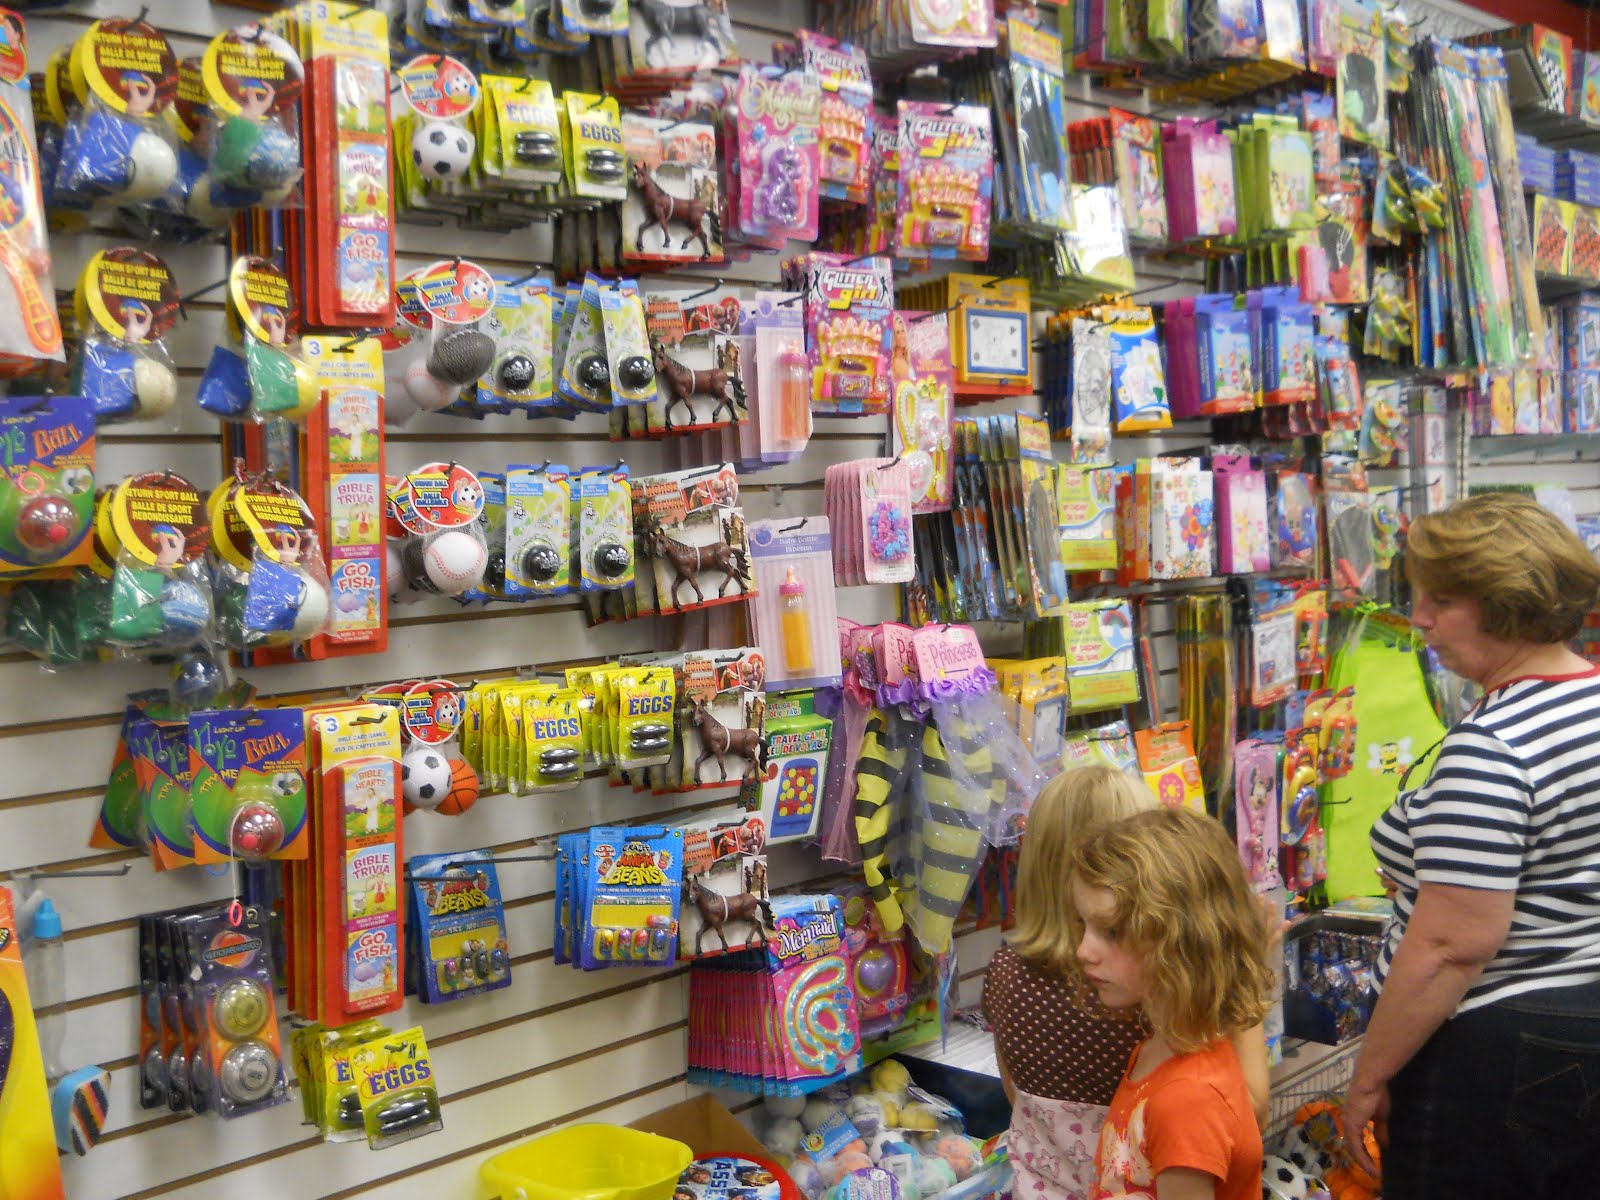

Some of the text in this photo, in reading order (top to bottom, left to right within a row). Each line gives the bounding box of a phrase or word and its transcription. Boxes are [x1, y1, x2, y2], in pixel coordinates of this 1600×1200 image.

[580, 122, 622, 143] EGGS
[352, 234, 376, 248] GO
[347, 247, 383, 261] FISH
[308, 341, 320, 355] 3
[155, 490, 179, 500] SPORT
[180, 491, 199, 502] BALL
[338, 483, 374, 495] BIBLE
[337, 494, 374, 506] TRIVIA
[131, 501, 192, 514] BALLE DE SPORT
[345, 563, 369, 577] GO
[339, 578, 373, 591] FISH
[928, 641, 977, 668] Princess
[629, 695, 673, 716] EGGS
[325, 718, 338, 732] 3
[534, 718, 579, 739] EGGS
[771, 734, 802, 747] TRAVEL
[782, 744, 793, 754] DE
[175, 771, 192, 782] ME
[200, 769, 239, 794] TRY ME
[358, 769, 383, 780] BIBLE
[355, 779, 386, 791] HEARTS
[353, 854, 390, 869] BIBLE
[353, 865, 390, 880] TRIVIA
[607, 868, 661, 886] BEANS
[436, 892, 484, 915] BEANS
[361, 932, 385, 947] GO
[778, 914, 836, 956] Mermaid
[355, 946, 391, 962] FISH
[368, 1059, 431, 1095] EGGS
[707, 1161, 731, 1200] ASSE
